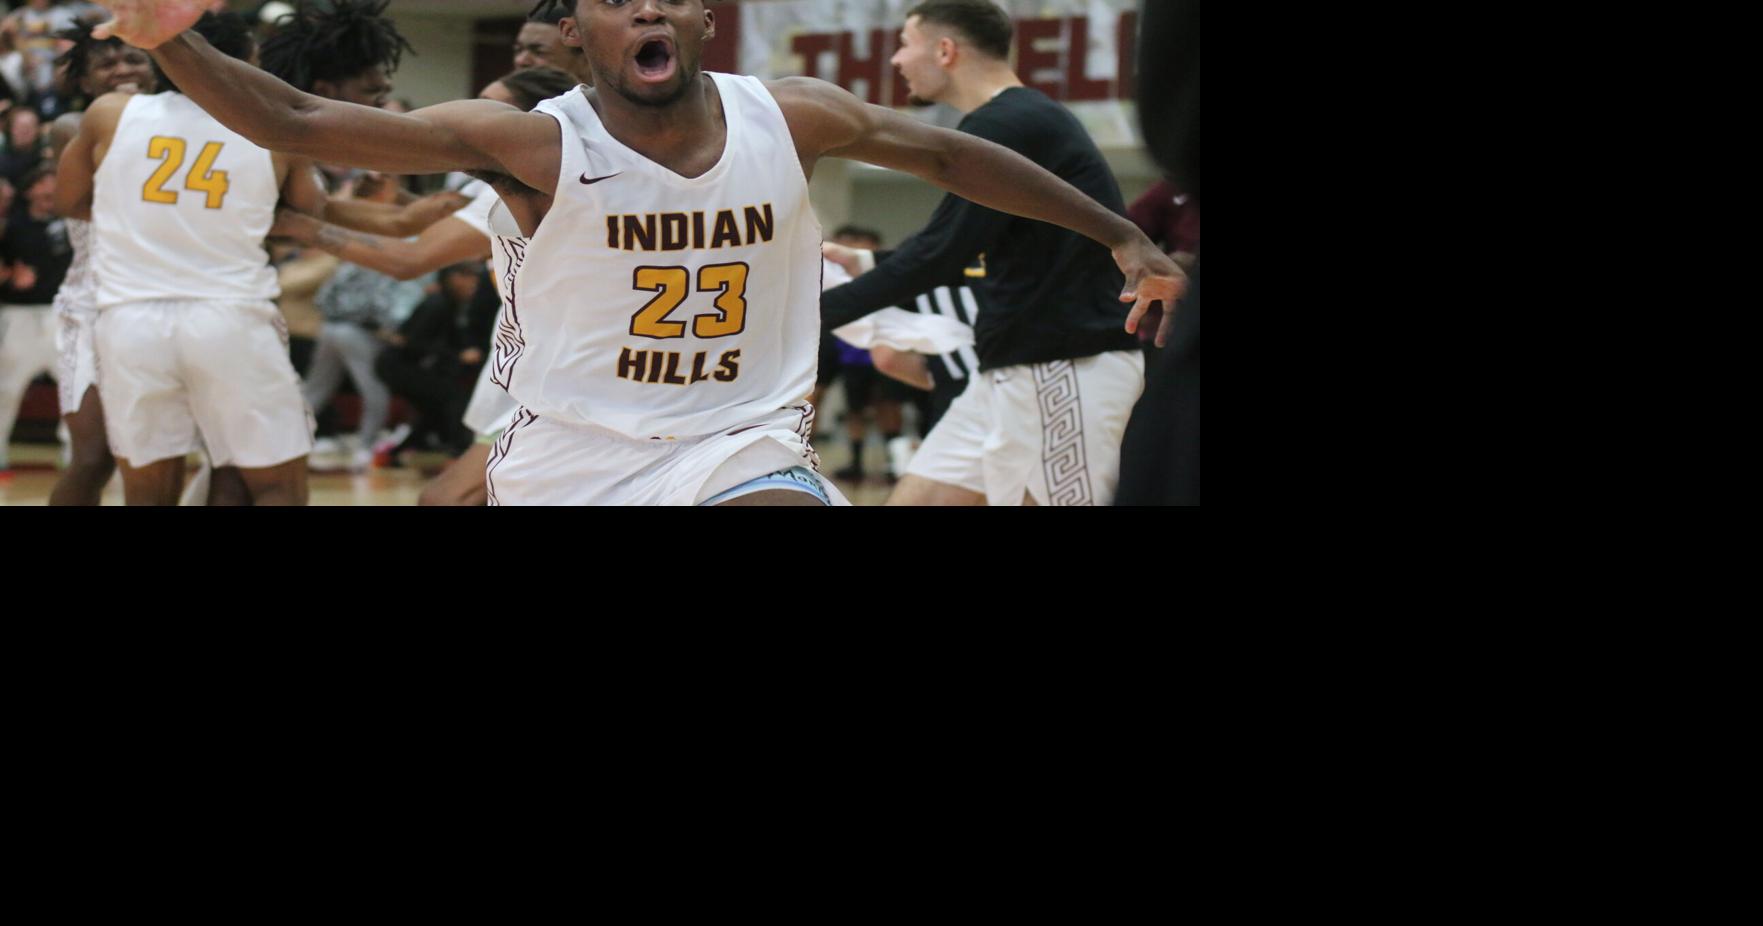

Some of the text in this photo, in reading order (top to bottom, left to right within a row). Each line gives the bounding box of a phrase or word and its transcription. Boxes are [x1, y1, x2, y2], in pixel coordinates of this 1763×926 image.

[142, 135, 229, 209] 24
[606, 203, 774, 251] INDIAN
[629, 261, 749, 340] 23
[616, 347, 741, 385] HILLS
